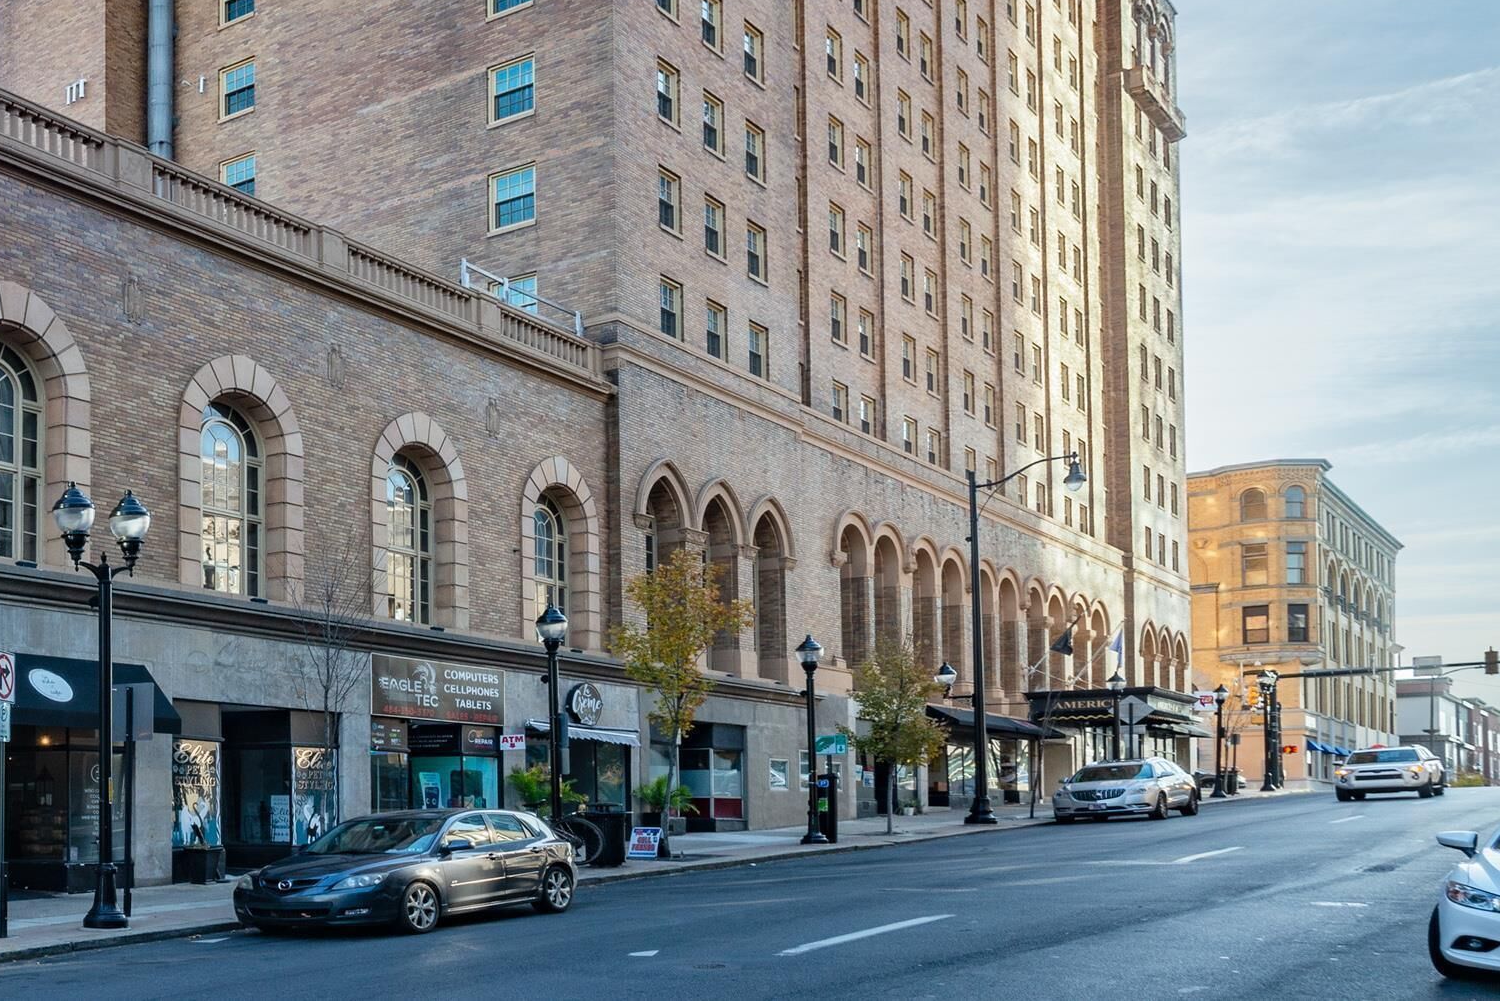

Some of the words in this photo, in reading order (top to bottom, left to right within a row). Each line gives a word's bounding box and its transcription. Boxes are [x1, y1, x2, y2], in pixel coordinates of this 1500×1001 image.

[443, 669, 500, 685] COMPUTERS
[379, 676, 422, 693] EAGLE
[443, 683, 500, 698] CELLPHONES
[414, 693, 439, 708] TEC
[454, 697, 492, 711] TABLETS
[1054, 699, 1114, 710] AMERIC
[501, 735, 524, 744] ATM
[173, 742, 215, 764] Elite
[296, 749, 332, 769] Elie
[187, 765, 204, 775] PET
[308, 770, 324, 779] PET
[175, 775, 216, 787] STYLING
